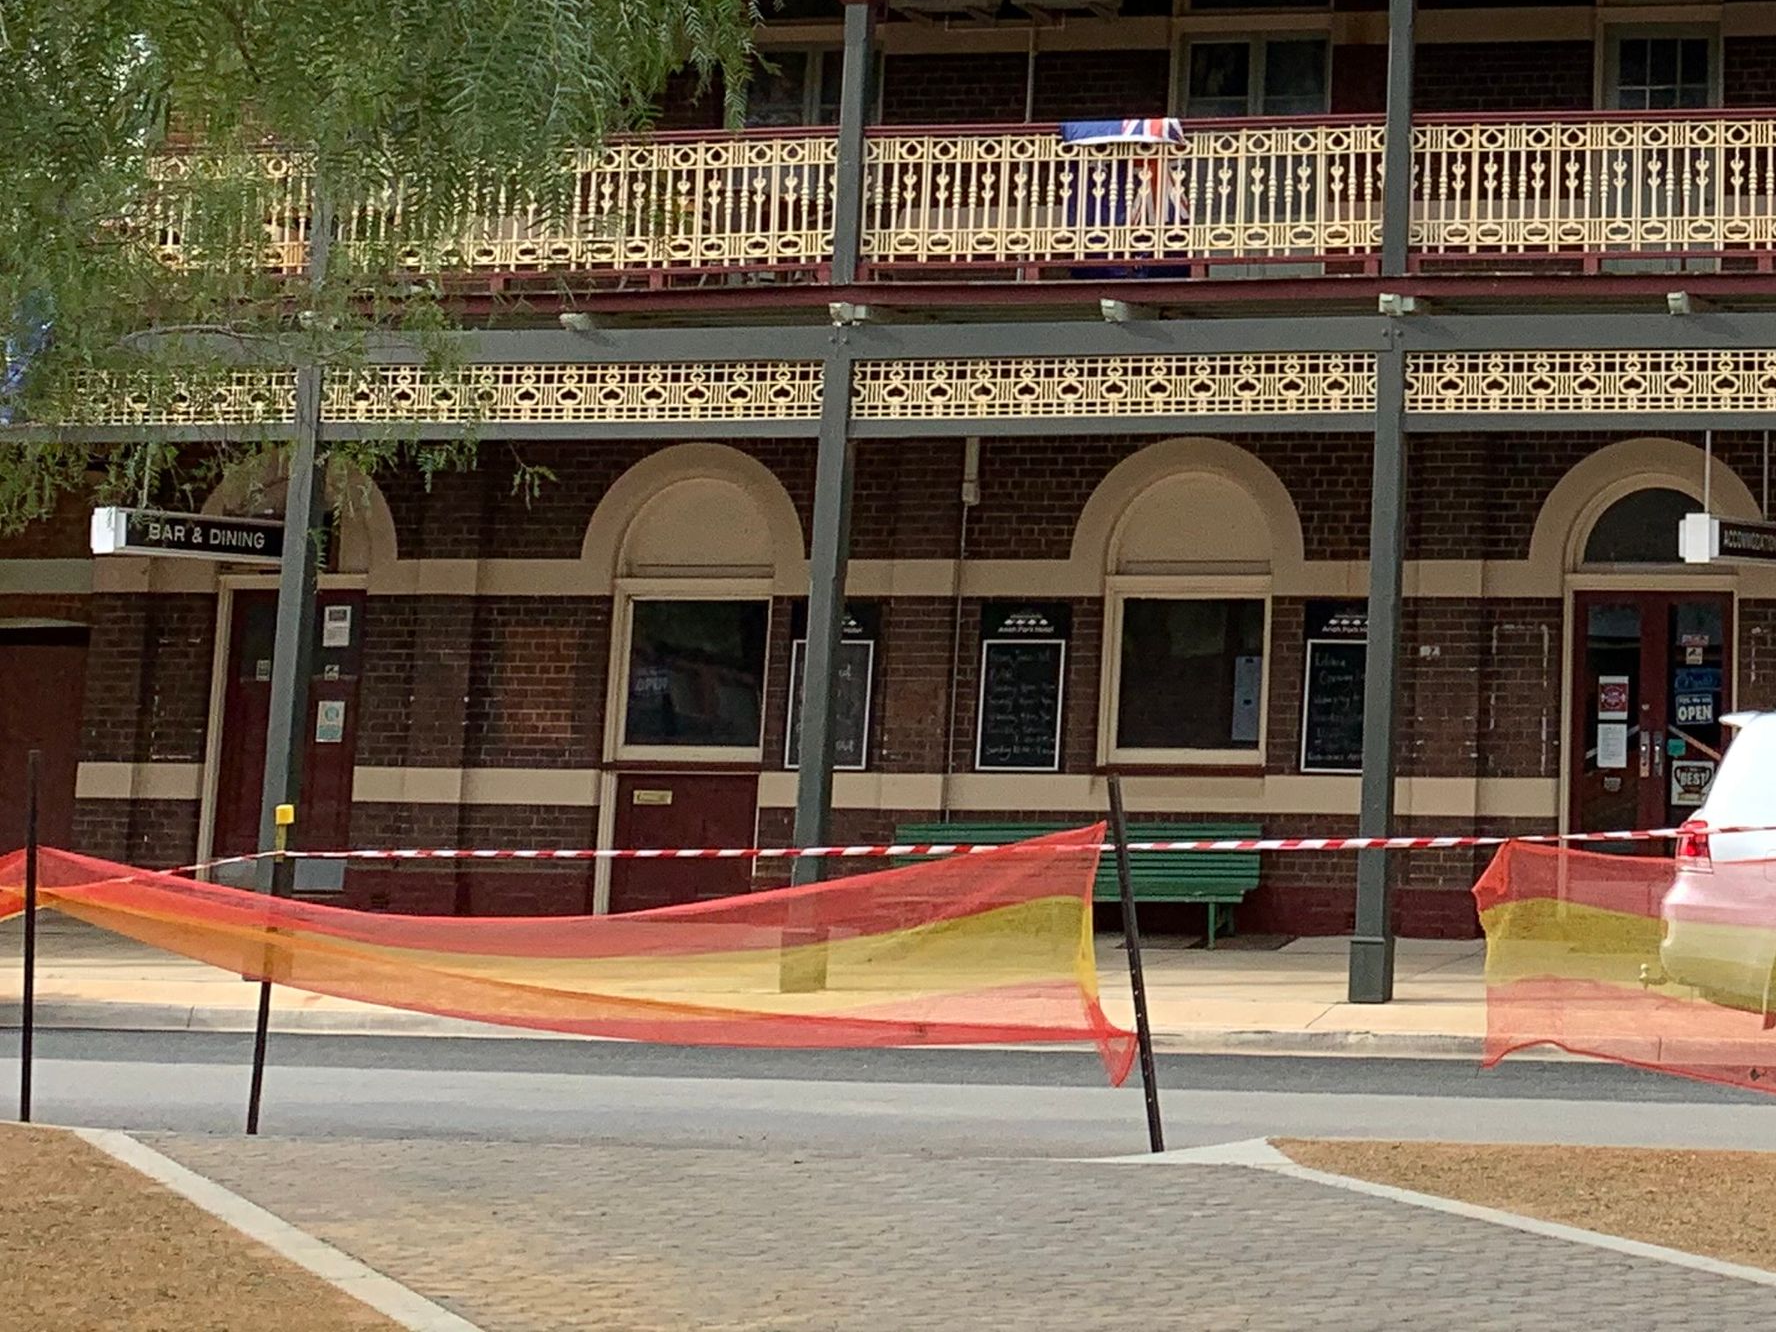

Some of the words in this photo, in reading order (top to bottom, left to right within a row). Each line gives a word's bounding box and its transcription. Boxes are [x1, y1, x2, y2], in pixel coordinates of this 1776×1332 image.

[148, 522, 186, 543] BAR
[191, 526, 203, 544] &
[208, 527, 266, 550] DINING
[1678, 705, 1712, 721] OPEN
[1680, 772, 1706, 787] BEST
